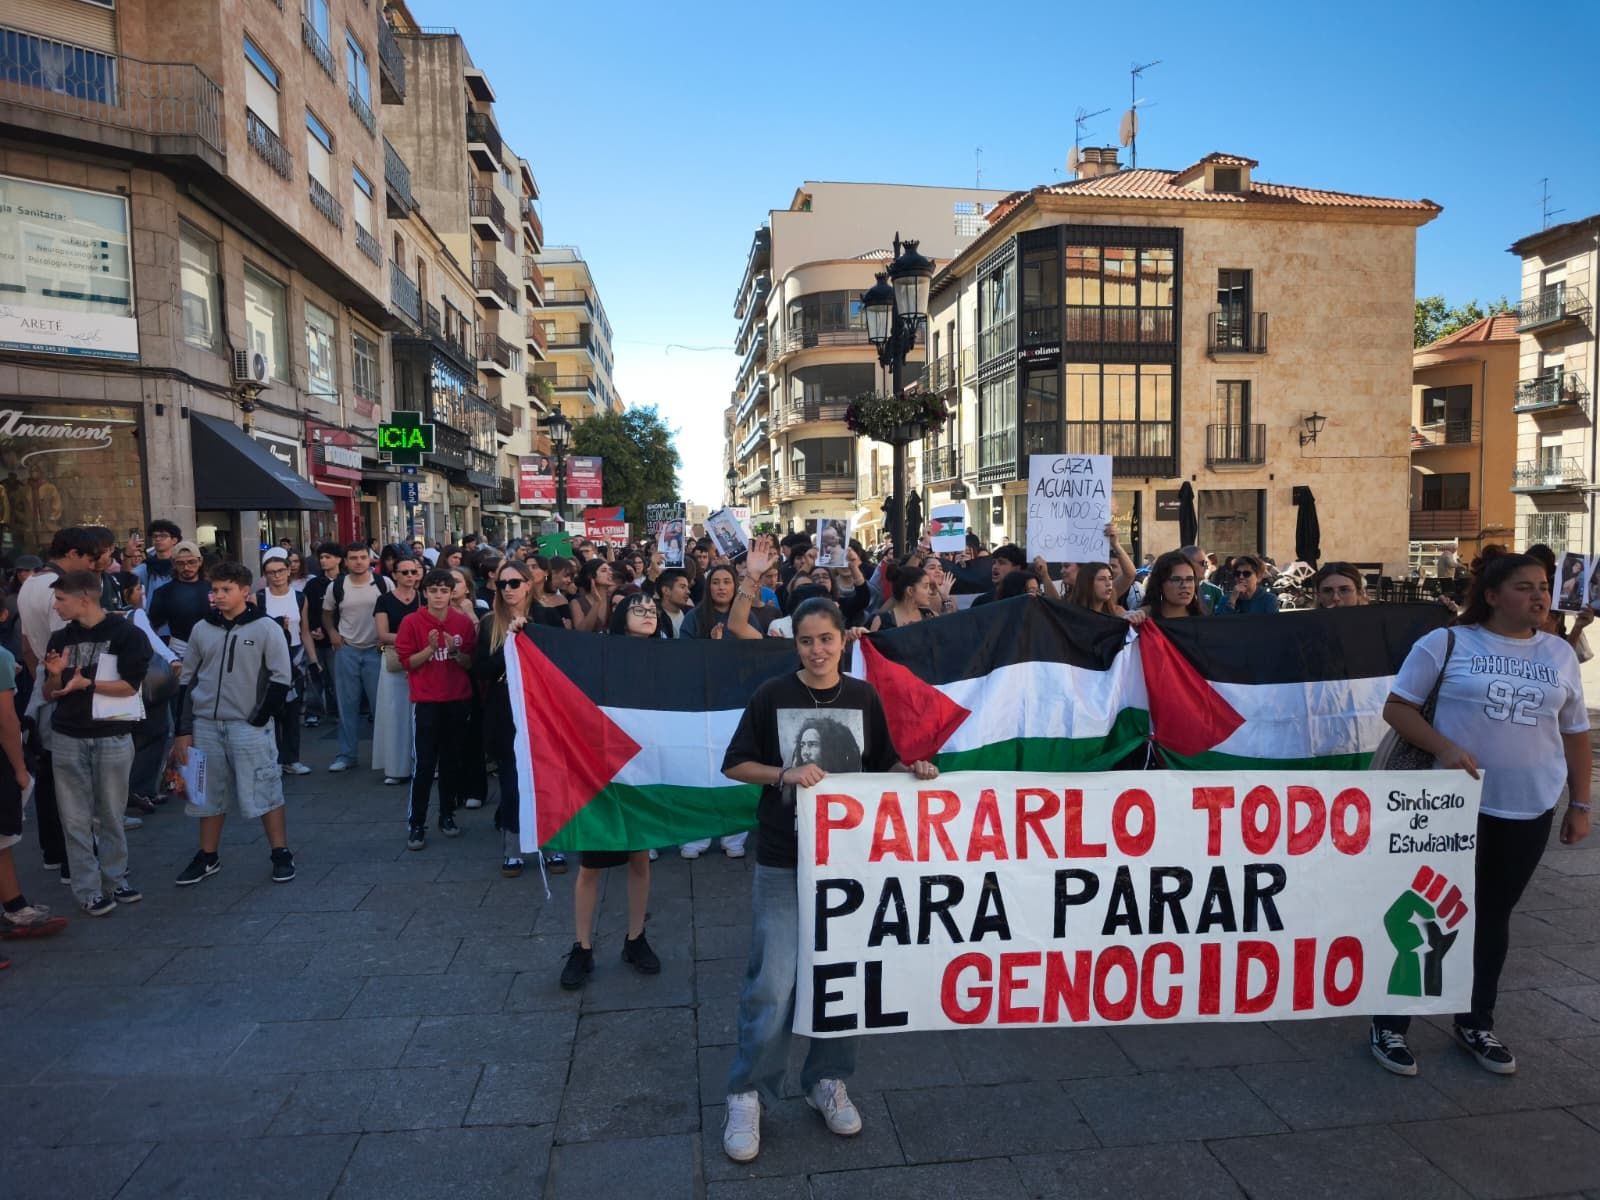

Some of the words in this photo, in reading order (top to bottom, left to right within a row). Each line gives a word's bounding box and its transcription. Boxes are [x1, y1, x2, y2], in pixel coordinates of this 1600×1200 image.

[1051, 458, 1094, 475] GAZA
[1035, 477, 1106, 499] AGUANTA
[1030, 503, 1043, 519] EL
[1050, 502, 1091, 519] MUNDO
[1471, 654, 1560, 688] CHICAGO
[1483, 680, 1544, 726] 92
[815, 788, 1156, 866] PARARLO
[1192, 785, 1371, 857] TODO
[1409, 813, 1429, 830] de
[1389, 833, 1475, 854] Estudiantes
[814, 871, 1011, 951] PARA
[1053, 863, 1287, 938] PARAR
[812, 960, 908, 1032] EL
[940, 936, 1364, 1025] GENOCIDIO
